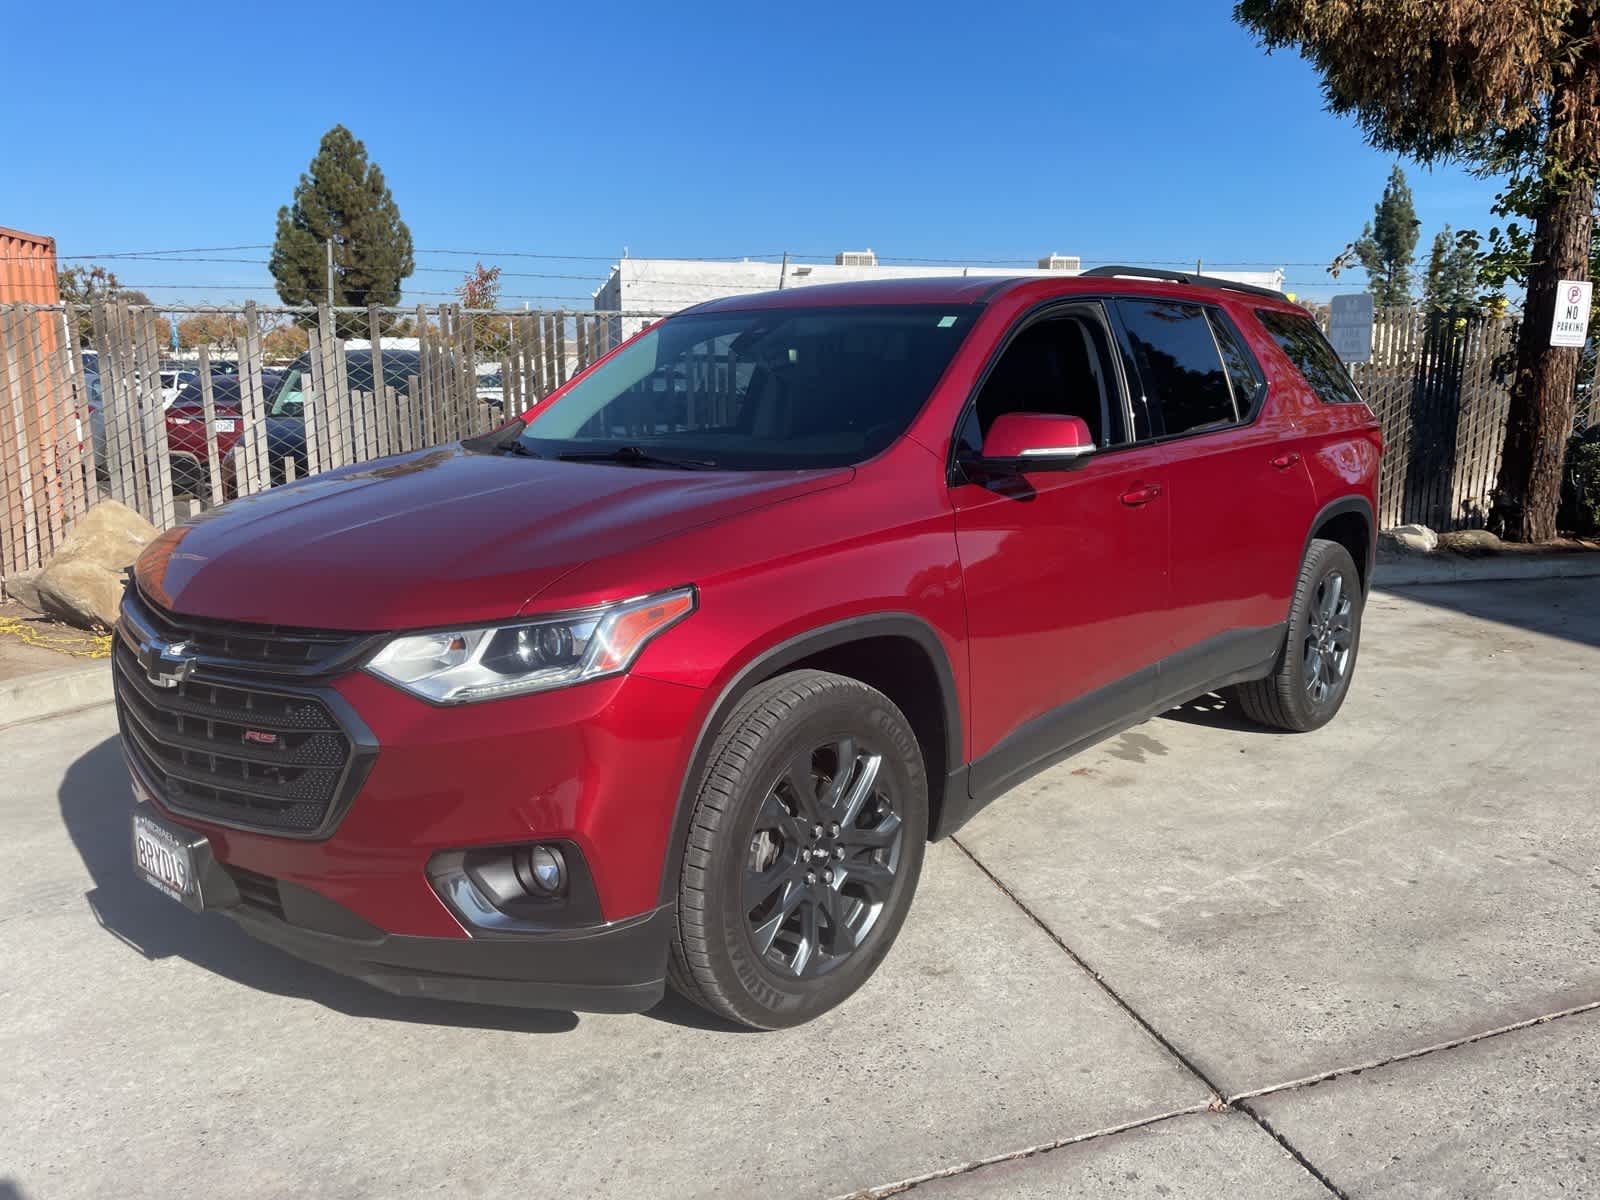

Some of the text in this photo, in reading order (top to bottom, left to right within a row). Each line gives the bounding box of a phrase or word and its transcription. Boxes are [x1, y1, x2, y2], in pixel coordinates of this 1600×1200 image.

[1566, 306, 1578, 320] NO
[1556, 322, 1584, 332] PARKING
[246, 731, 276, 743] RS
